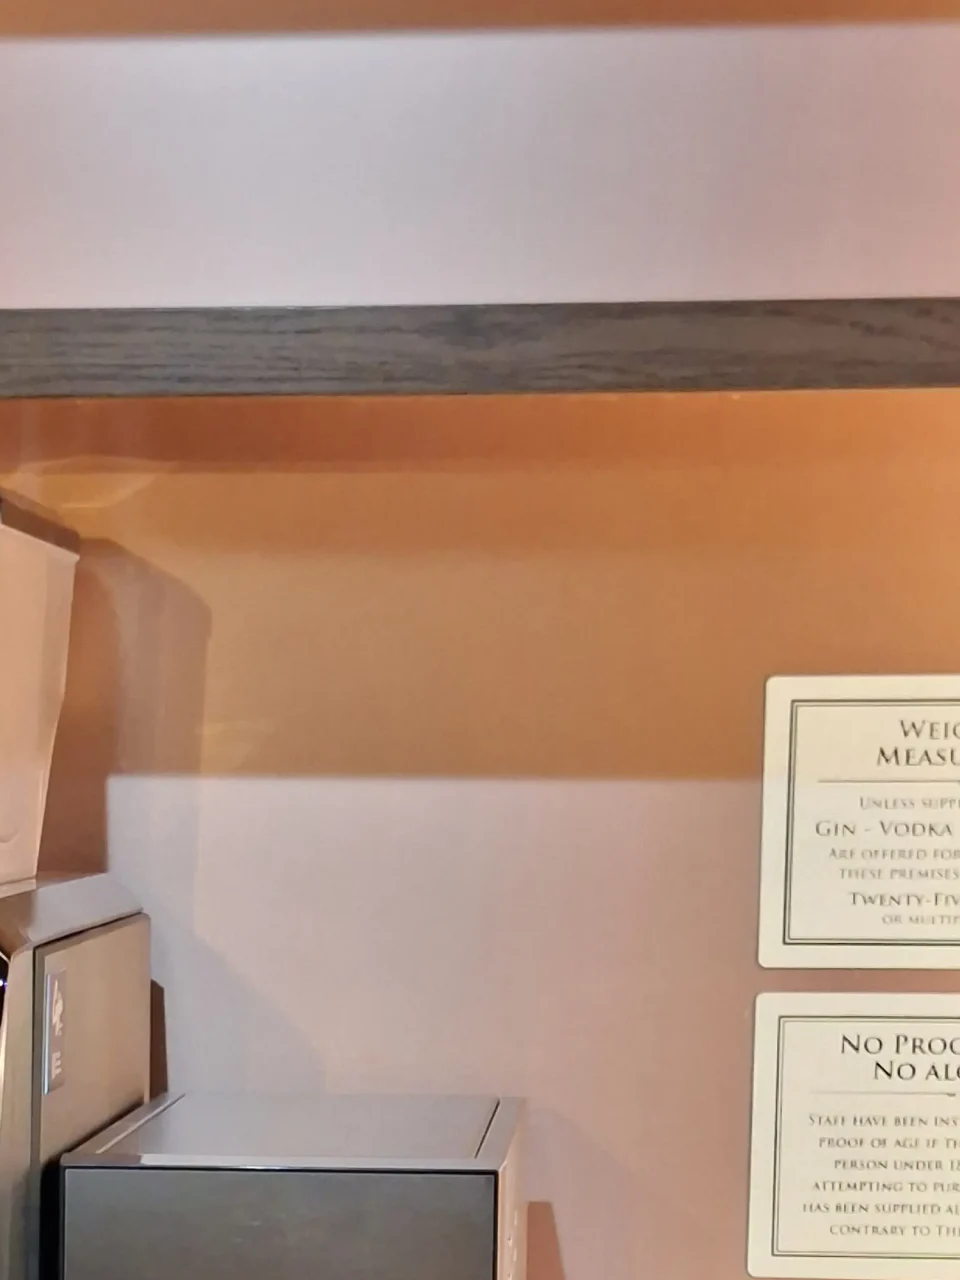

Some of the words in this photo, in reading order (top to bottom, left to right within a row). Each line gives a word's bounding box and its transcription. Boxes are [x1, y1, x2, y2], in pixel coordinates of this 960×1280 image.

[815, 821, 856, 837] GIN
[879, 820, 953, 837] VODKA
[841, 1034, 883, 1054] NO
[874, 1061, 916, 1081] NO
[853, 1115, 887, 1127] HAVE
[894, 1116, 928, 1127] BEEN
[834, 1159, 888, 1170] PERSON
[893, 1160, 943, 1171] UNDER
[813, 1181, 904, 1193] ATTEMPTING
[909, 1182, 928, 1193] TO
[803, 1203, 830, 1213] HAS
[835, 1203, 869, 1214] BEEN
[875, 1204, 942, 1215] SUPPLIED
